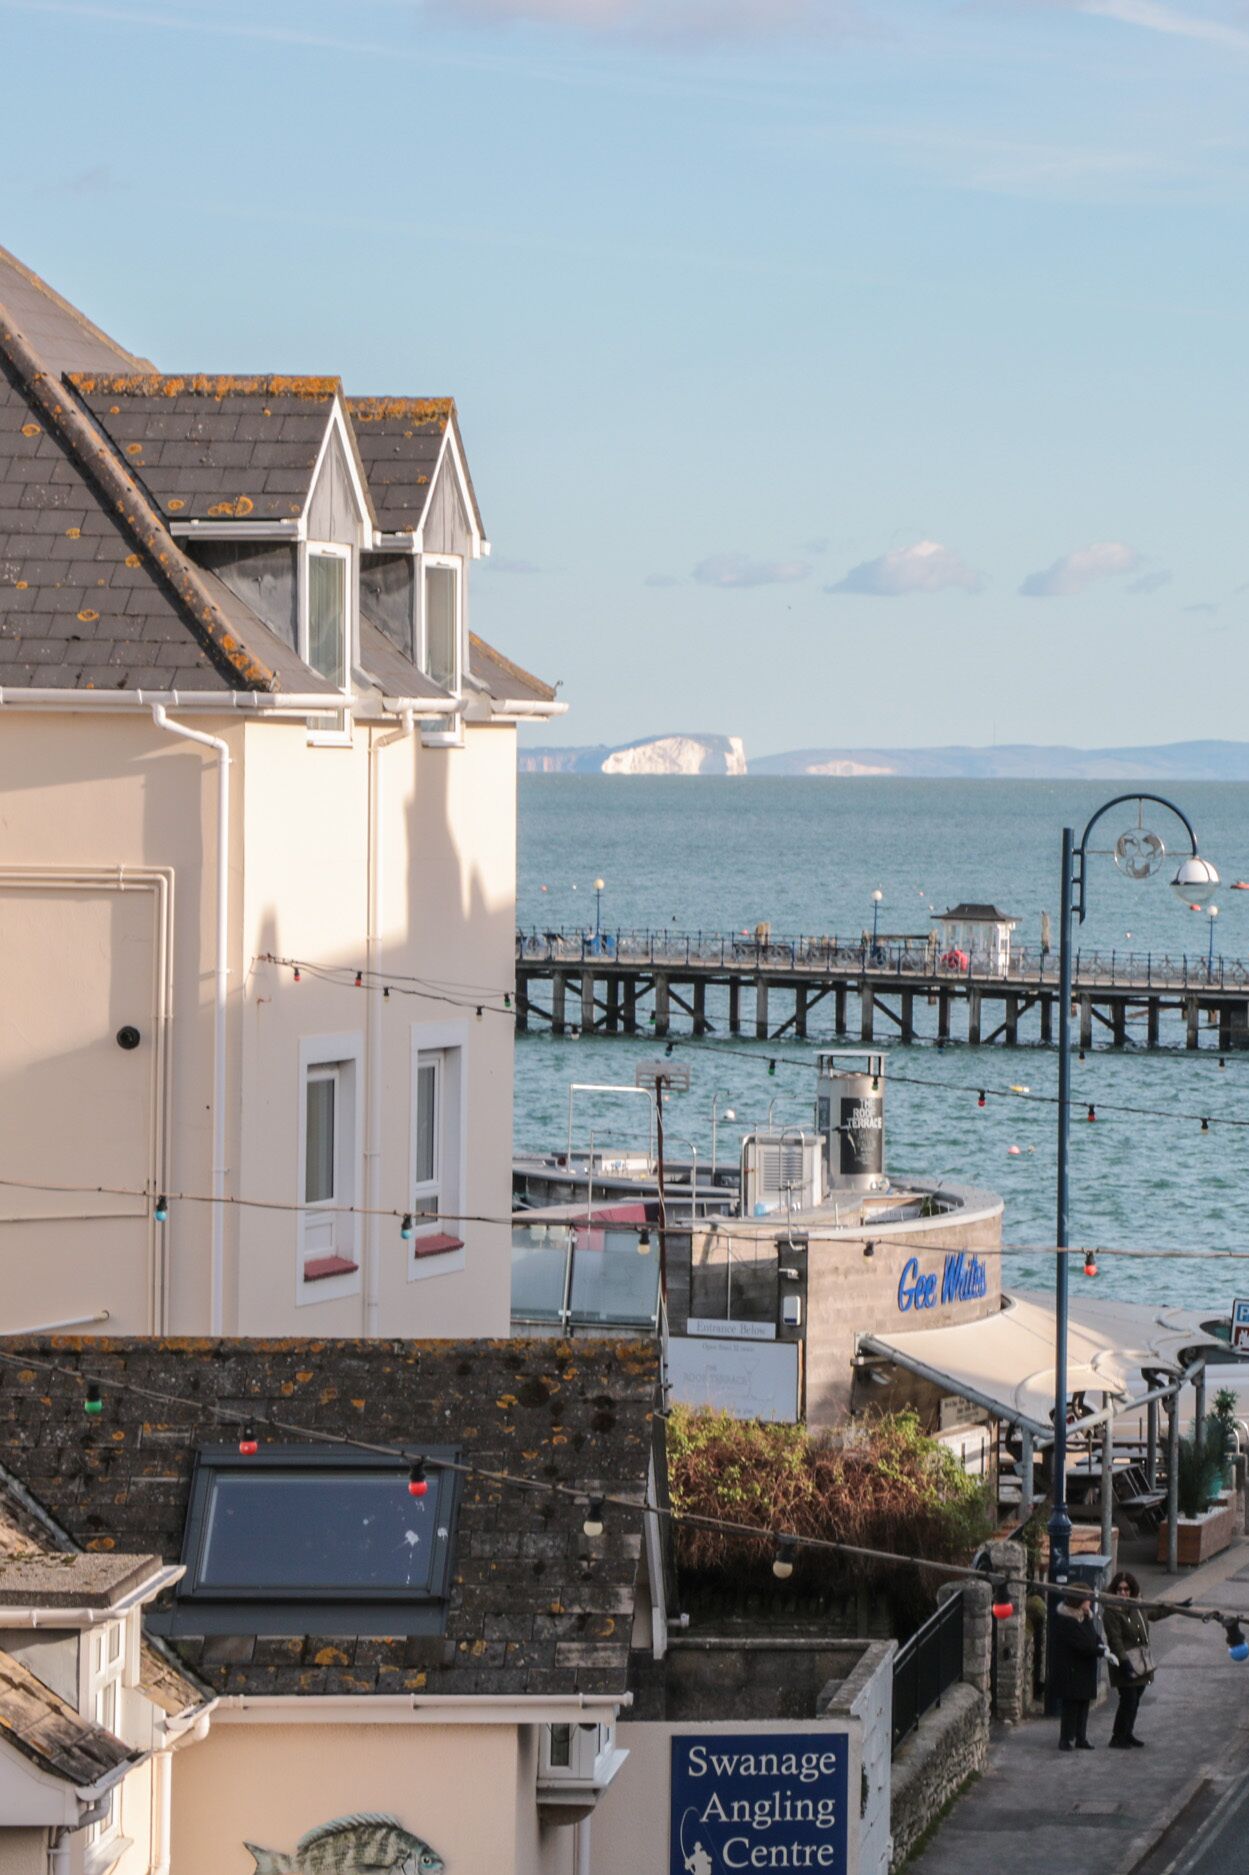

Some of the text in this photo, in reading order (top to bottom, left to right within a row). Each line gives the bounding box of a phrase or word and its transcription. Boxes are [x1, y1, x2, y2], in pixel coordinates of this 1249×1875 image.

[847, 1117, 882, 1128] TERRACE
[898, 1257, 937, 1312] Gee
[697, 1320, 766, 1336] Entrance Below
[688, 1746, 836, 1783] Swanage
[700, 1790, 836, 1829] Angling
[722, 1837, 834, 1868] Centre
